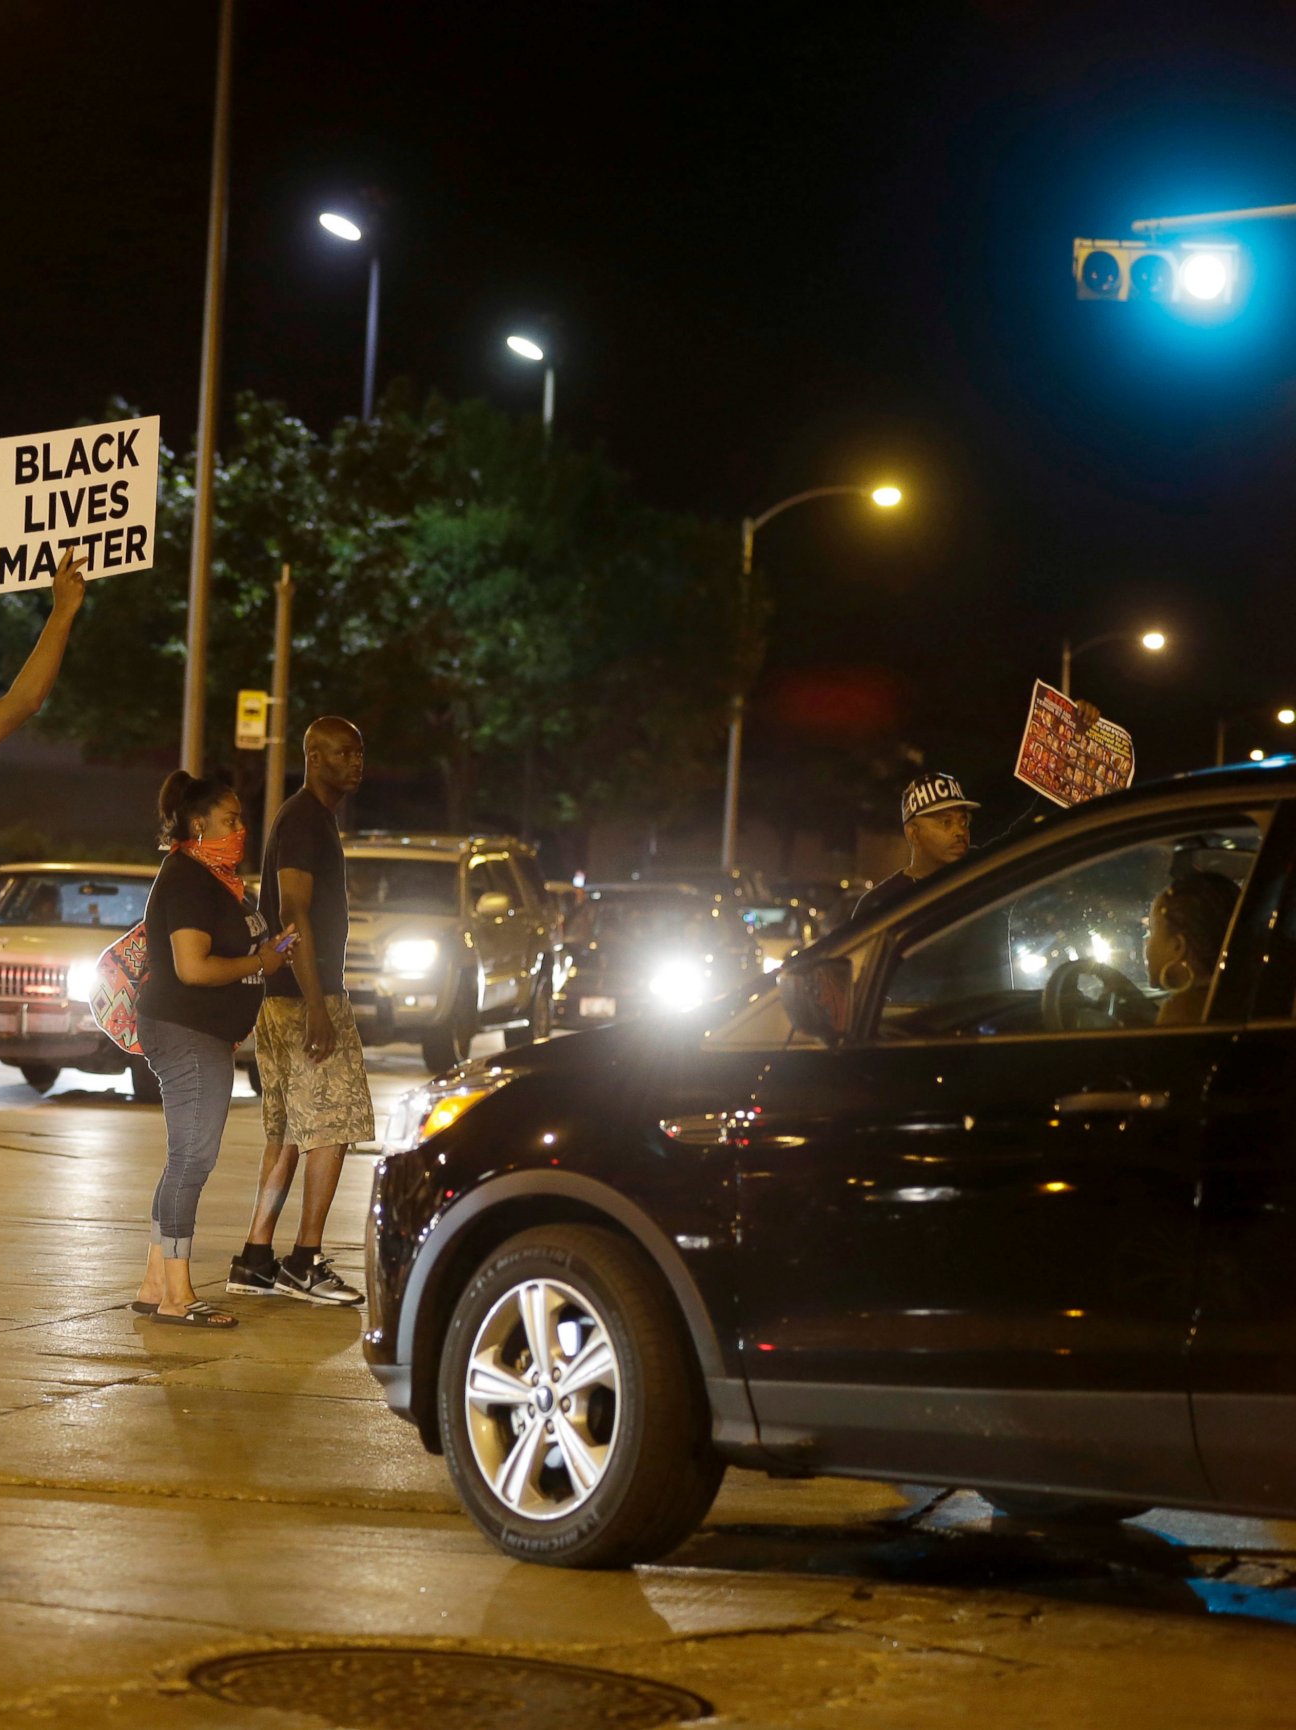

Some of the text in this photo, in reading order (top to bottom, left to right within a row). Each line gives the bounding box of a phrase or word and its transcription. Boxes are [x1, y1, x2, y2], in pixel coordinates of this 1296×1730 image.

[15, 428, 141, 485] BLACK
[24, 480, 129, 533] LIVES
[1047, 690, 1073, 713] STOP
